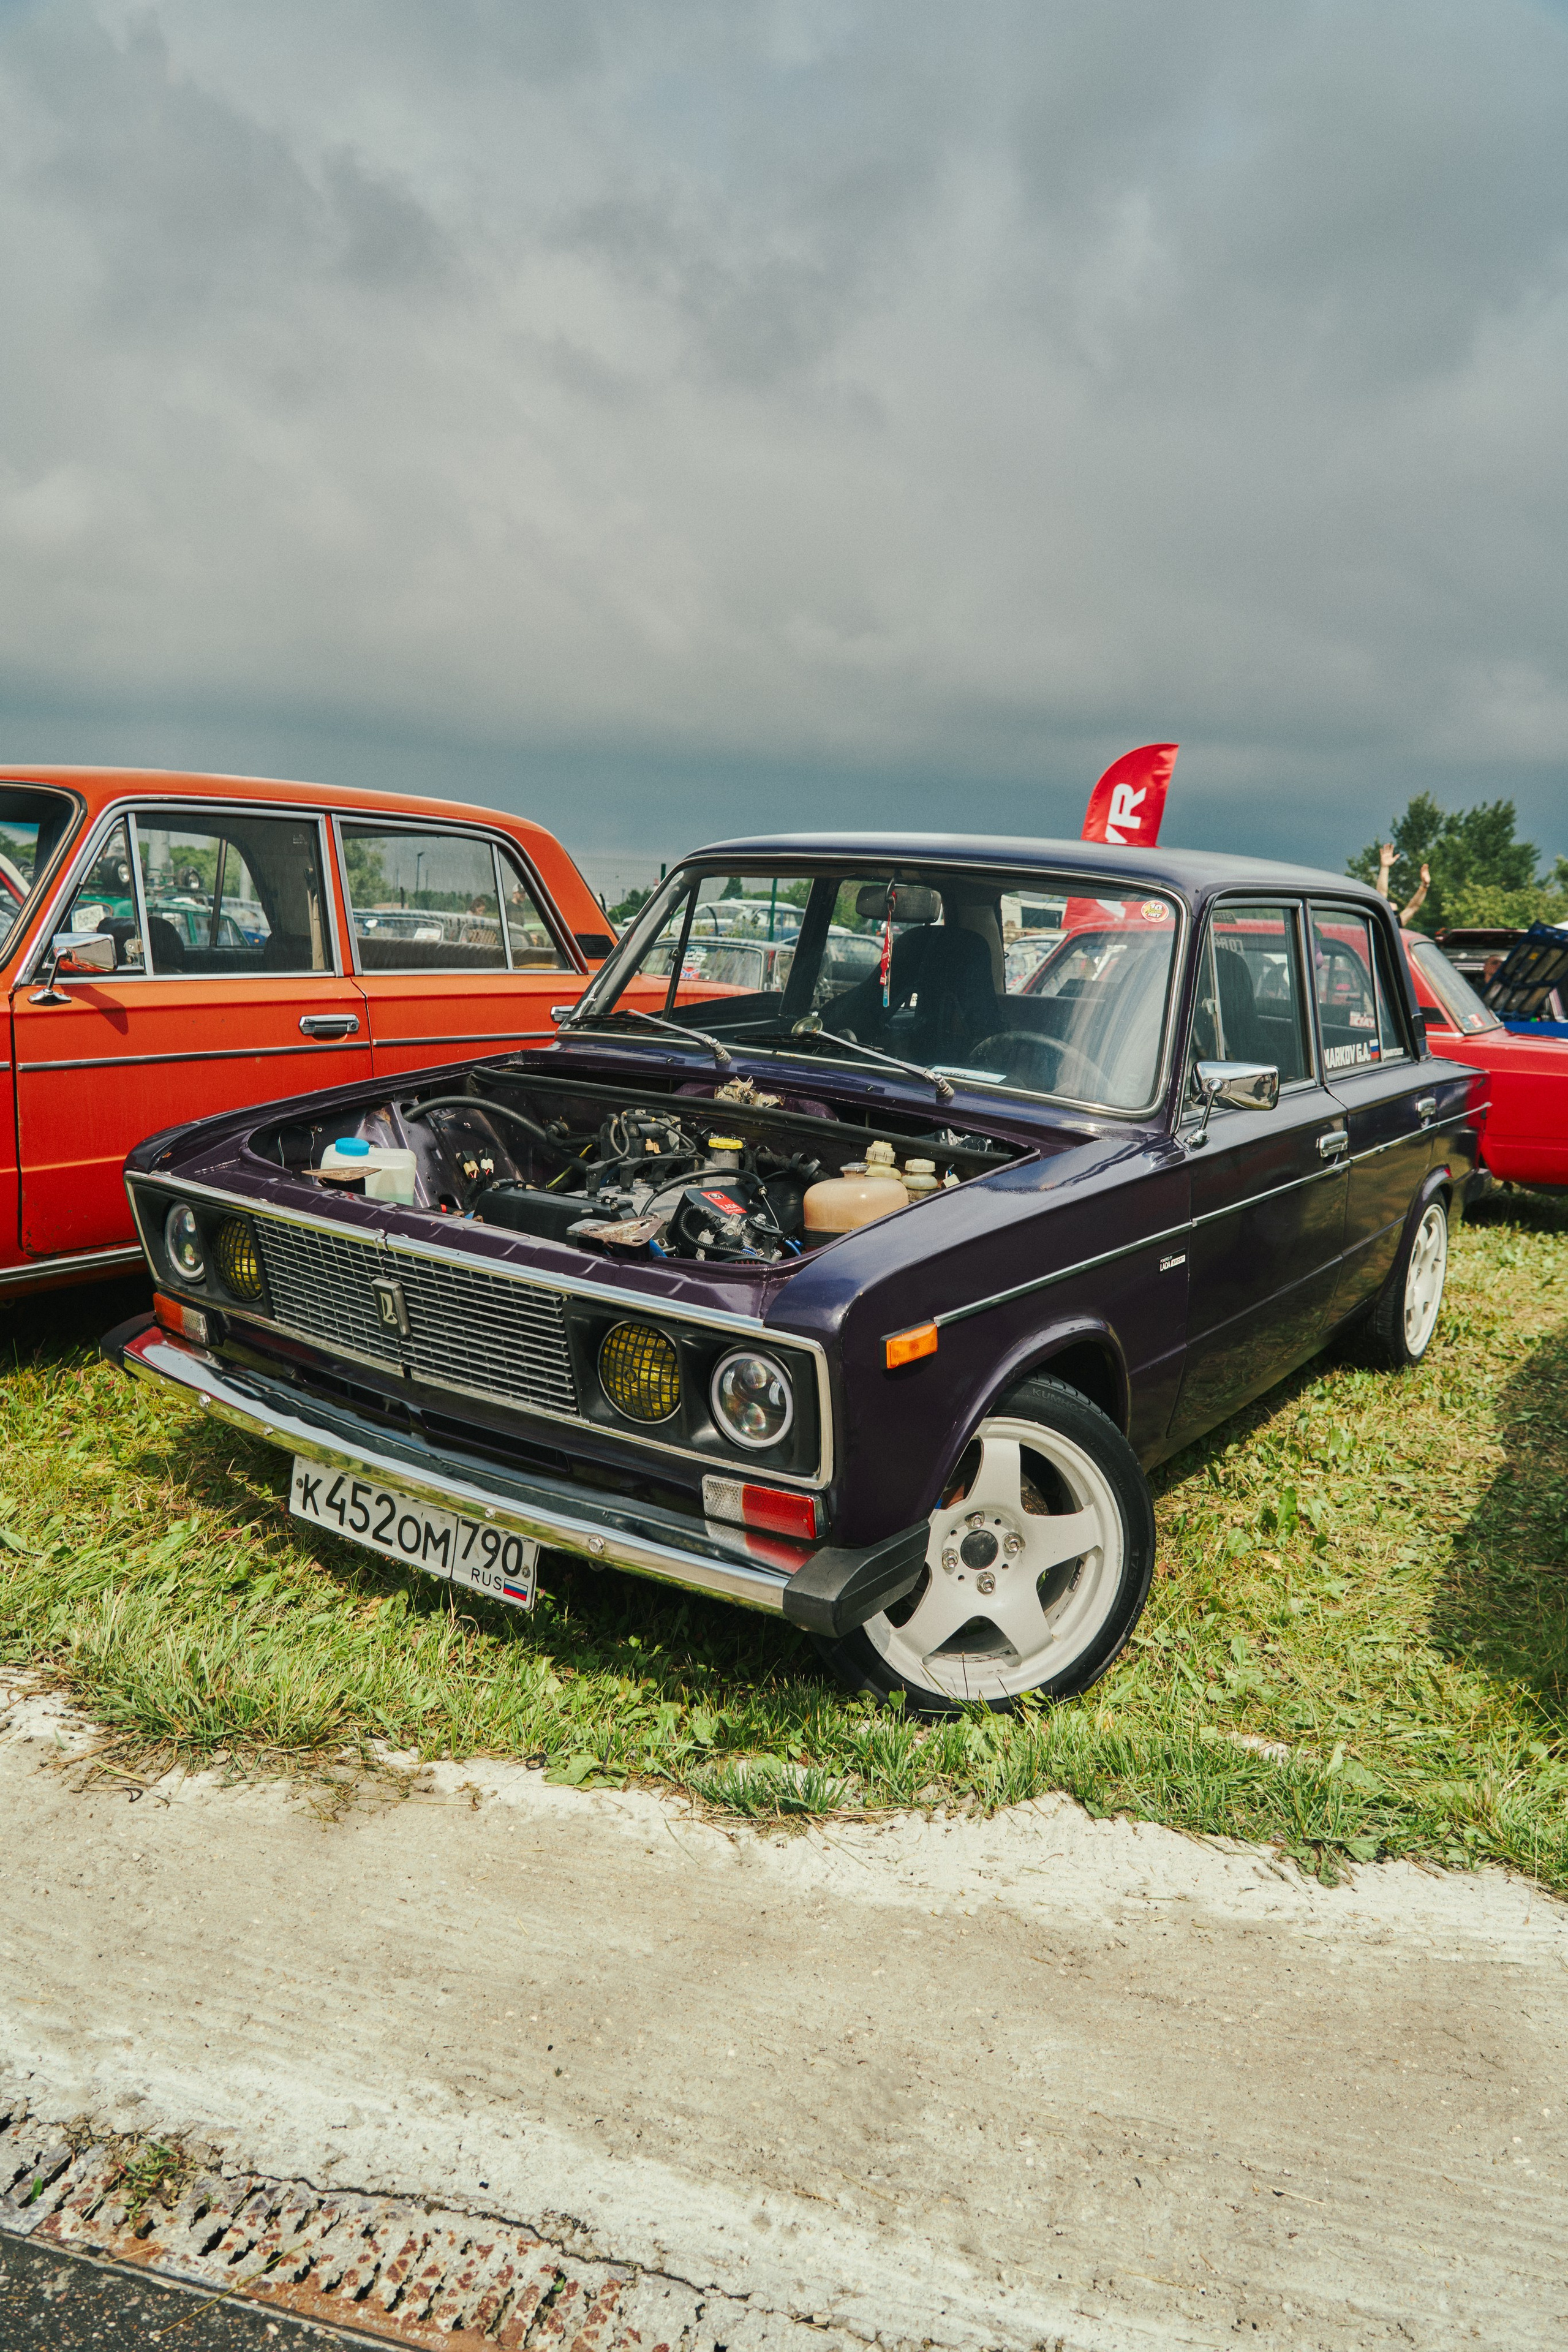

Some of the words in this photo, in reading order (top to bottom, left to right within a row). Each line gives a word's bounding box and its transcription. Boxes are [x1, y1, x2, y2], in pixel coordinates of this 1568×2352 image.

[1324, 1044, 1355, 1069] MARKOV
[1160, 1261, 1170, 1272] LADA
[1172, 1256, 1185, 1265] SPORT
[1032, 1388, 1078, 1411] KUMHO
[461, 1519, 523, 1577] 790
[471, 1567, 502, 1591] RUS
